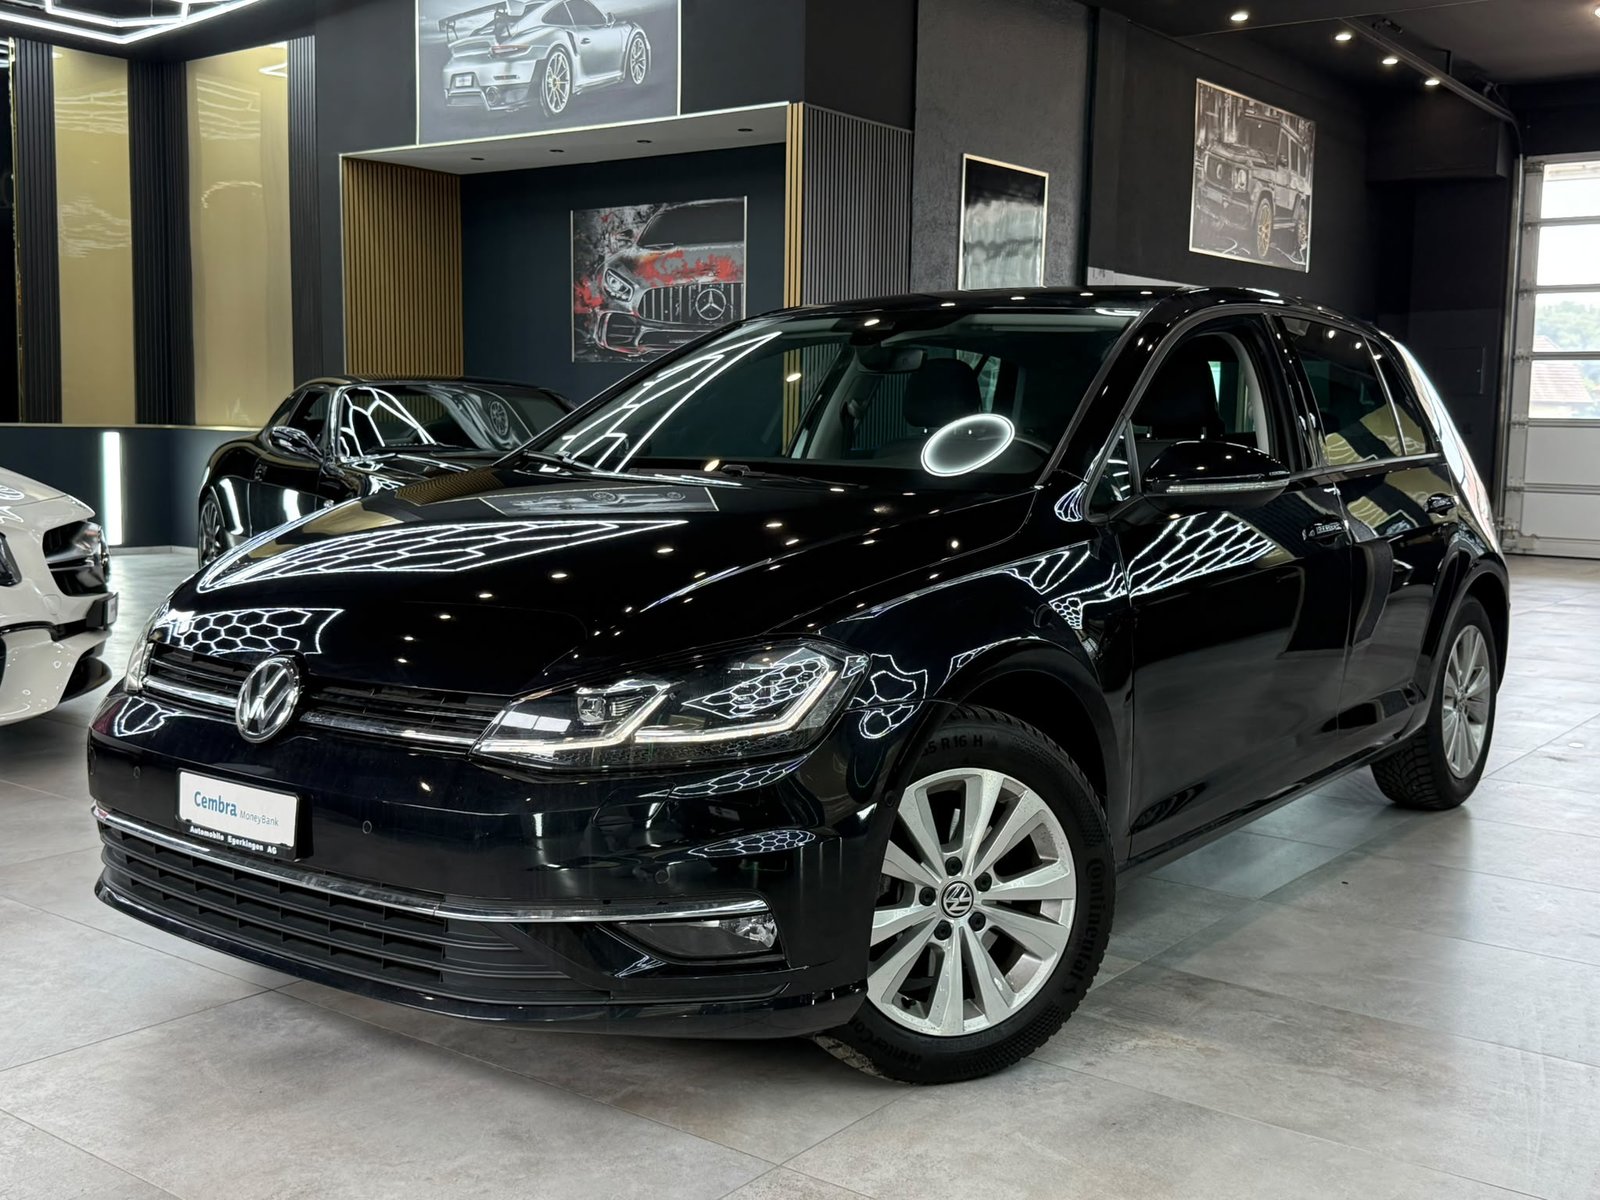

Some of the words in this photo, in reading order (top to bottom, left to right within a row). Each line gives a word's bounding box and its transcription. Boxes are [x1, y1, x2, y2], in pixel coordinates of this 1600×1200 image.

[941, 737, 950, 750] R
[953, 735, 967, 748] 16
[973, 734, 983, 747] H
[194, 791, 237, 817] Cembra
[239, 810, 279, 827] MoneyBank
[190, 826, 224, 841] Automobile
[227, 836, 264, 852] Egerkingen
[267, 846, 277, 855] AG
